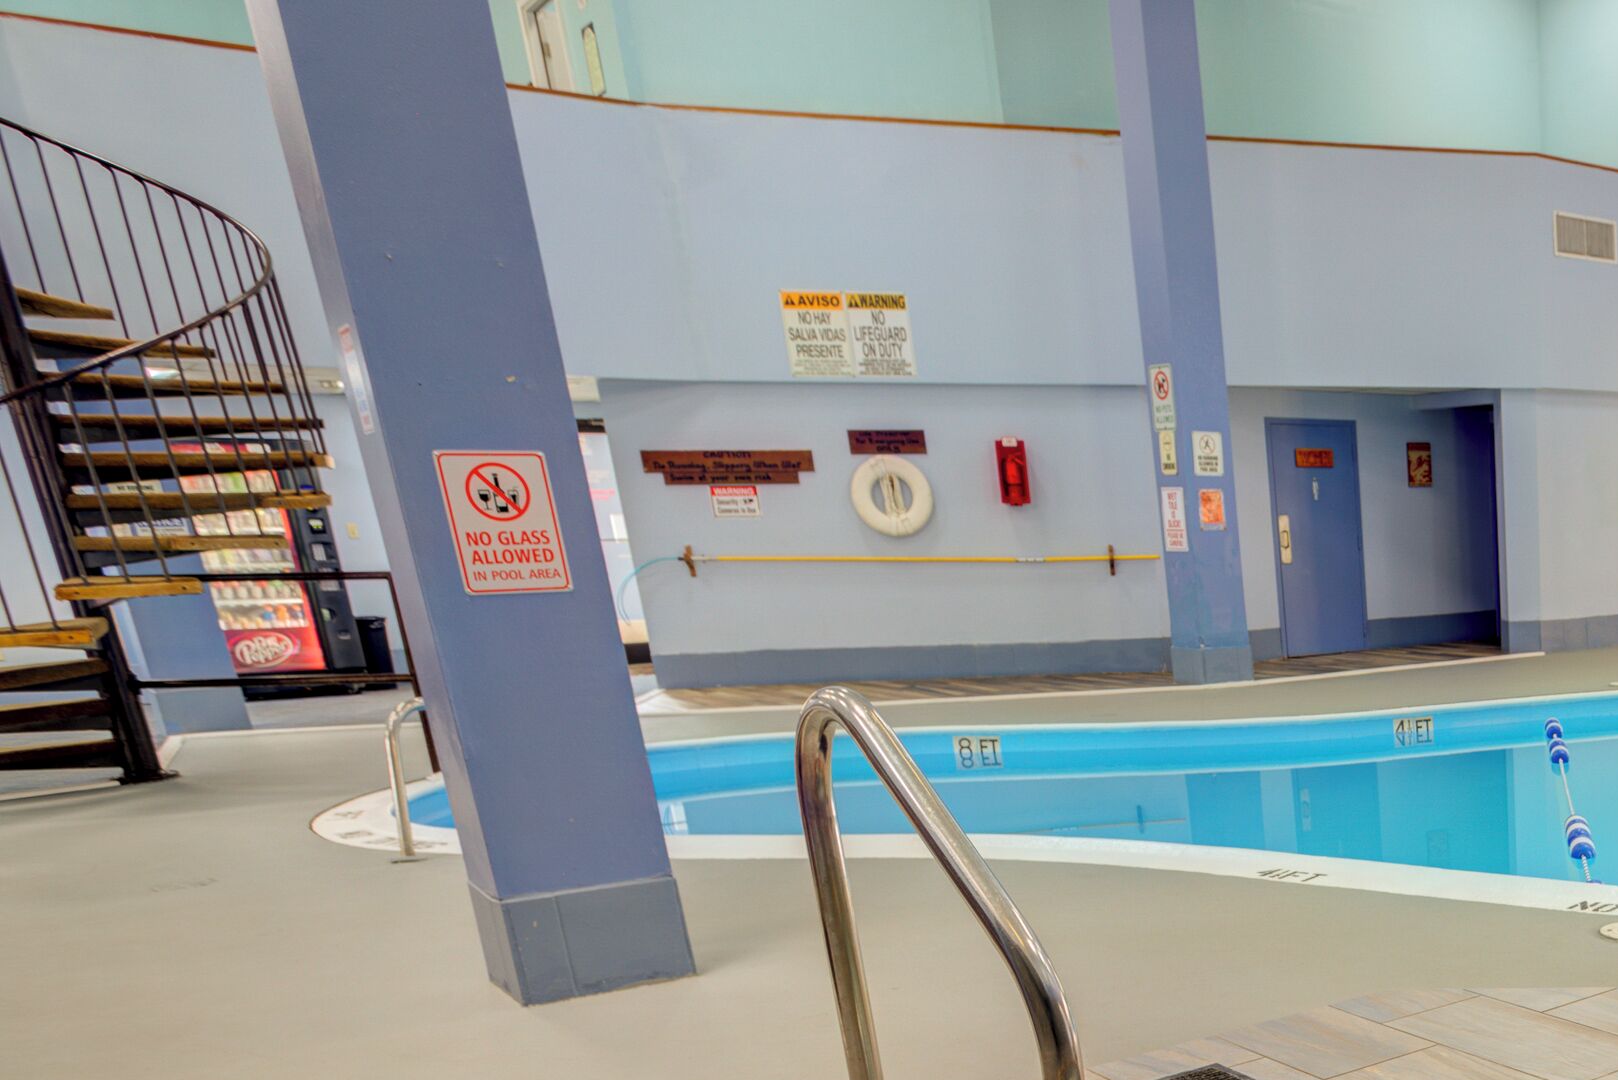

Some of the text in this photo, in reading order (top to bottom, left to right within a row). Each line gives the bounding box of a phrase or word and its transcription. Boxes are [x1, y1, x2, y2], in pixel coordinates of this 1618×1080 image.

[798, 295, 840, 307] AVISO
[859, 294, 906, 309] WARNING
[798, 311, 831, 325] NO HAY
[871, 311, 886, 326] NO
[788, 328, 846, 341] SALVA VIDAS
[853, 327, 907, 342] LIFEGUARD
[796, 344, 844, 358] PRESENTE
[862, 343, 903, 358] ON DUTY
[703, 451, 752, 459] CAUTION
[713, 487, 755, 495] WARNING
[465, 529, 551, 546] NO GLASS
[472, 548, 555, 565] ALLOWED
[473, 568, 562, 581] IN POOL AREA
[236, 638, 294, 665] Pepper
[1416, 718, 1431, 736] FT
[980, 739, 998, 757] FT
